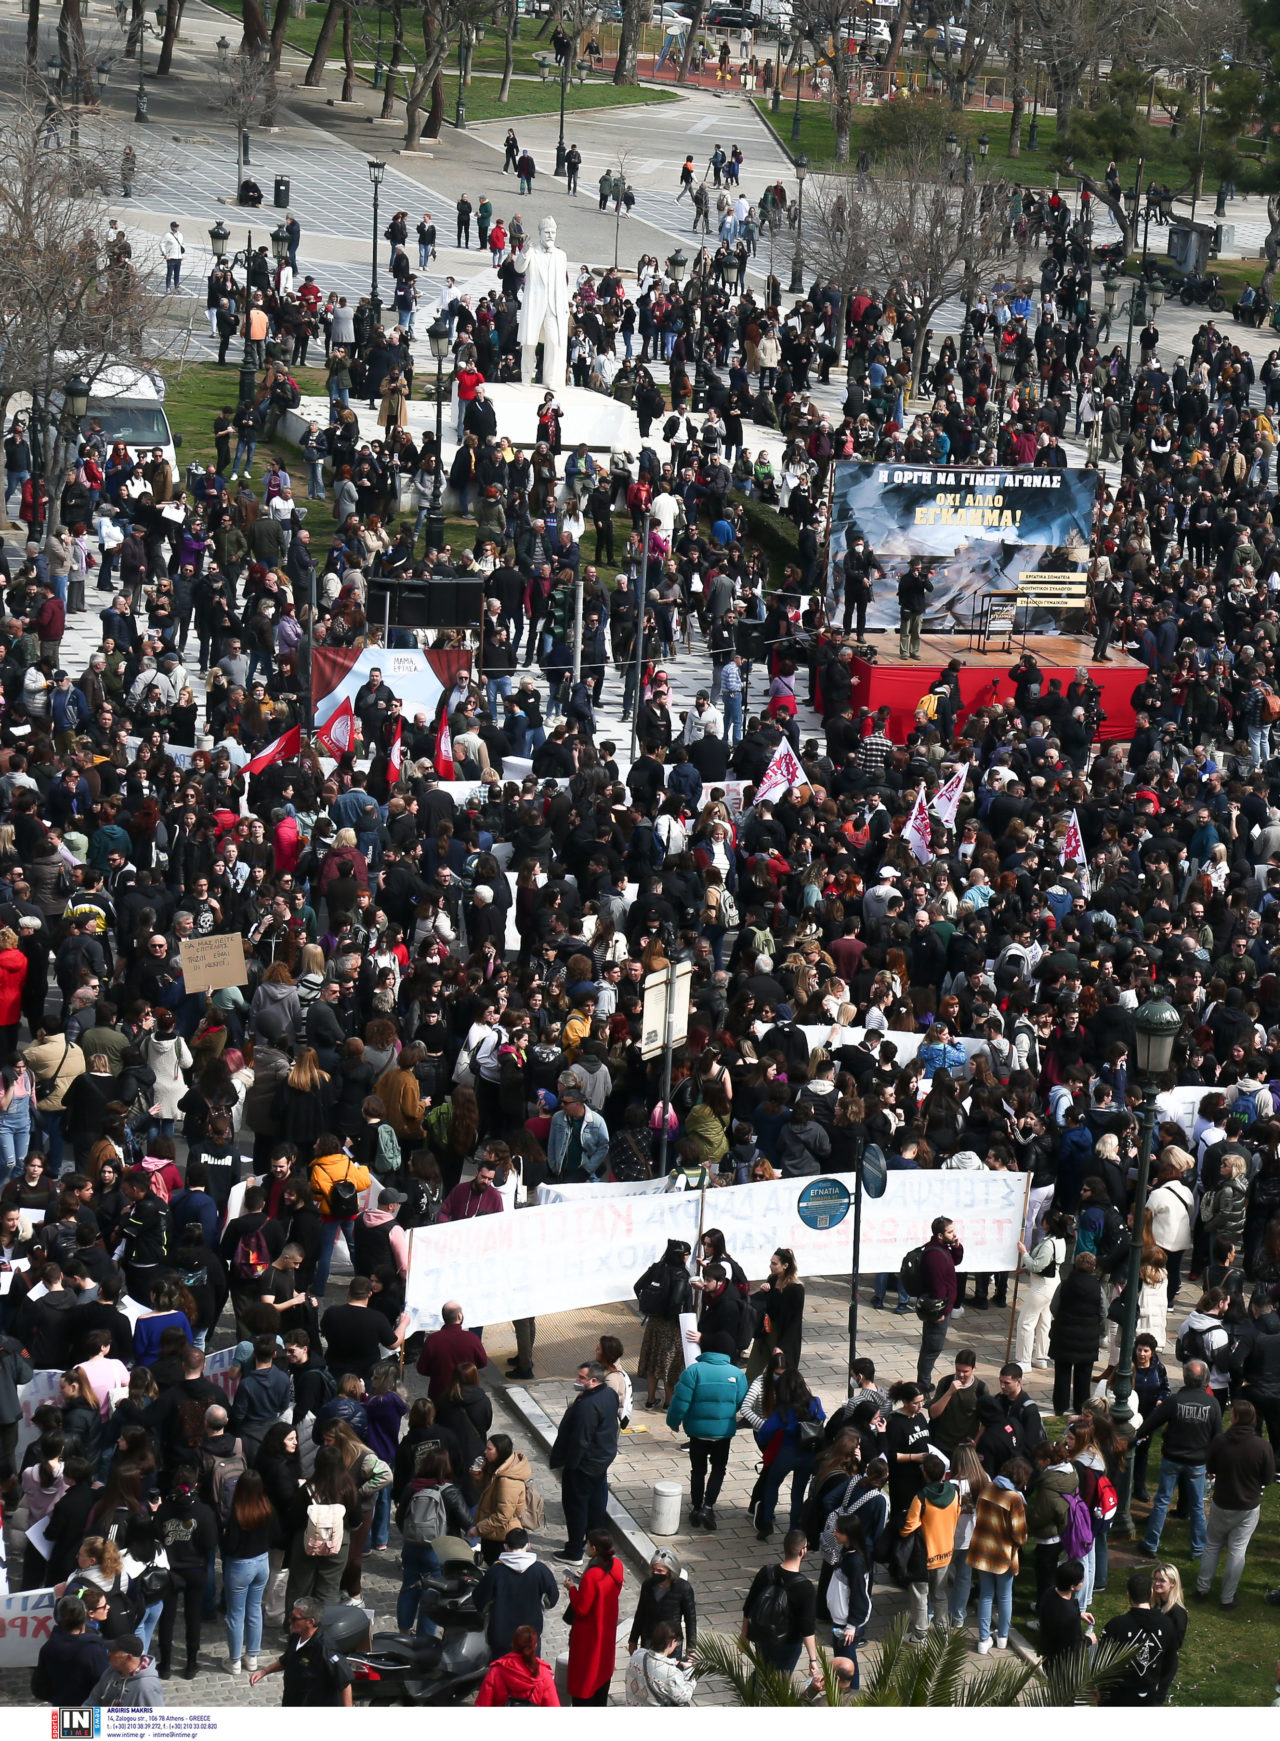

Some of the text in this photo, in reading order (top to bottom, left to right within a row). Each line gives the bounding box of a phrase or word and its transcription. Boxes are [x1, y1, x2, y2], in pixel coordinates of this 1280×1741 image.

[878, 470, 1062, 488] Η ΟΡΓΗ ΝΑ ΓΙΝΕΙ ΑΓΩΝΑΣ
[935, 492, 1004, 508] ΟΧΙ ΑΛΛΟ
[913, 507, 1023, 527] ΕΓΚΛΗΜΑ!
[200, 1153, 233, 1166] PUMA
[810, 1187, 840, 1197] ΕΓΝΑΤΙΑ
